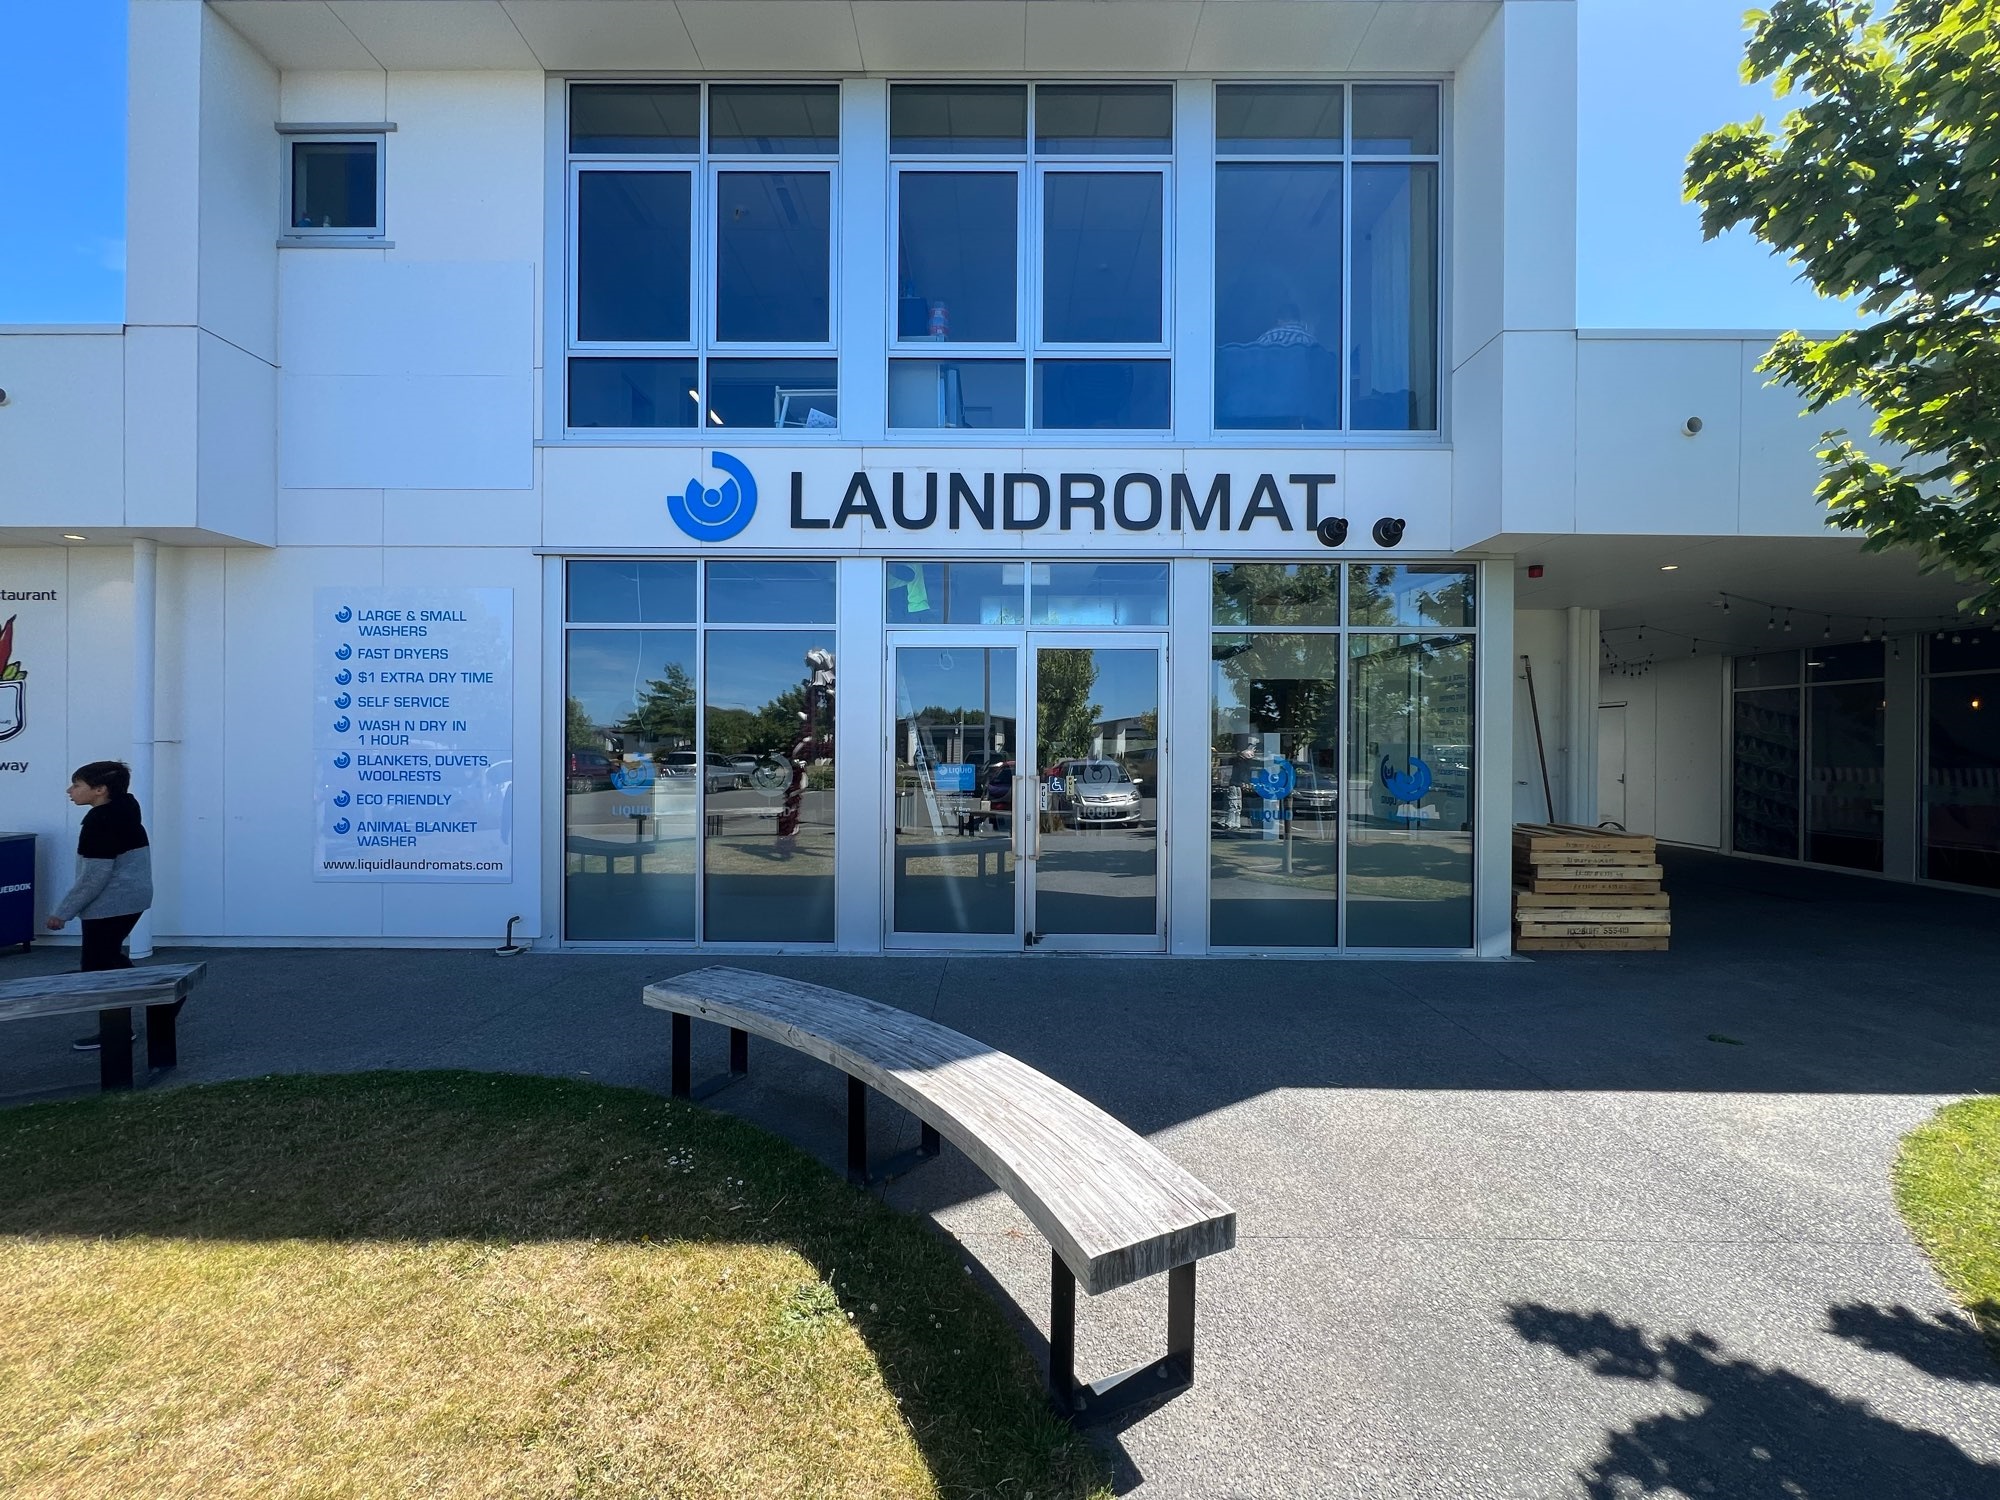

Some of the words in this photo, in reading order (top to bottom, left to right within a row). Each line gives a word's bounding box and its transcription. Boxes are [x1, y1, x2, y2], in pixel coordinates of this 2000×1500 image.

[790, 471, 1336, 532] LAUNDROMAT
[358, 610, 402, 622] LARGE
[406, 611, 416, 622] &
[420, 610, 467, 622] SMALL
[358, 626, 427, 637] WASHERS
[358, 649, 390, 660] FAST
[394, 649, 449, 660] DRYERS
[358, 672, 376, 684] $1
[380, 672, 424, 683] EXTRA
[428, 672, 457, 684] DRY
[460, 672, 494, 684] TIME
[358, 697, 390, 708] SELF
[394, 696, 450, 708] SERVICE
[358, 720, 400, 731] WASH
[404, 720, 415, 731] N
[420, 720, 447, 731] DRY
[452, 720, 467, 731] IN
[358, 735, 366, 745] 1
[371, 735, 409, 746] HOUR
[358, 755, 432, 768] BLANKETS,
[435, 756, 491, 768] DUVETS,
[358, 771, 442, 782] WOOLRESTS
[949, 767, 973, 775] LIQUID
[356, 794, 383, 805] ECO
[387, 794, 452, 806] FRIENDLY
[1077, 806, 1118, 819] LIQUID
[357, 822, 411, 833] ANIMAL
[415, 822, 477, 833] BLANKET
[358, 836, 417, 847] WASHER
[323, 859, 503, 872] www.liquidlaundromats.com
